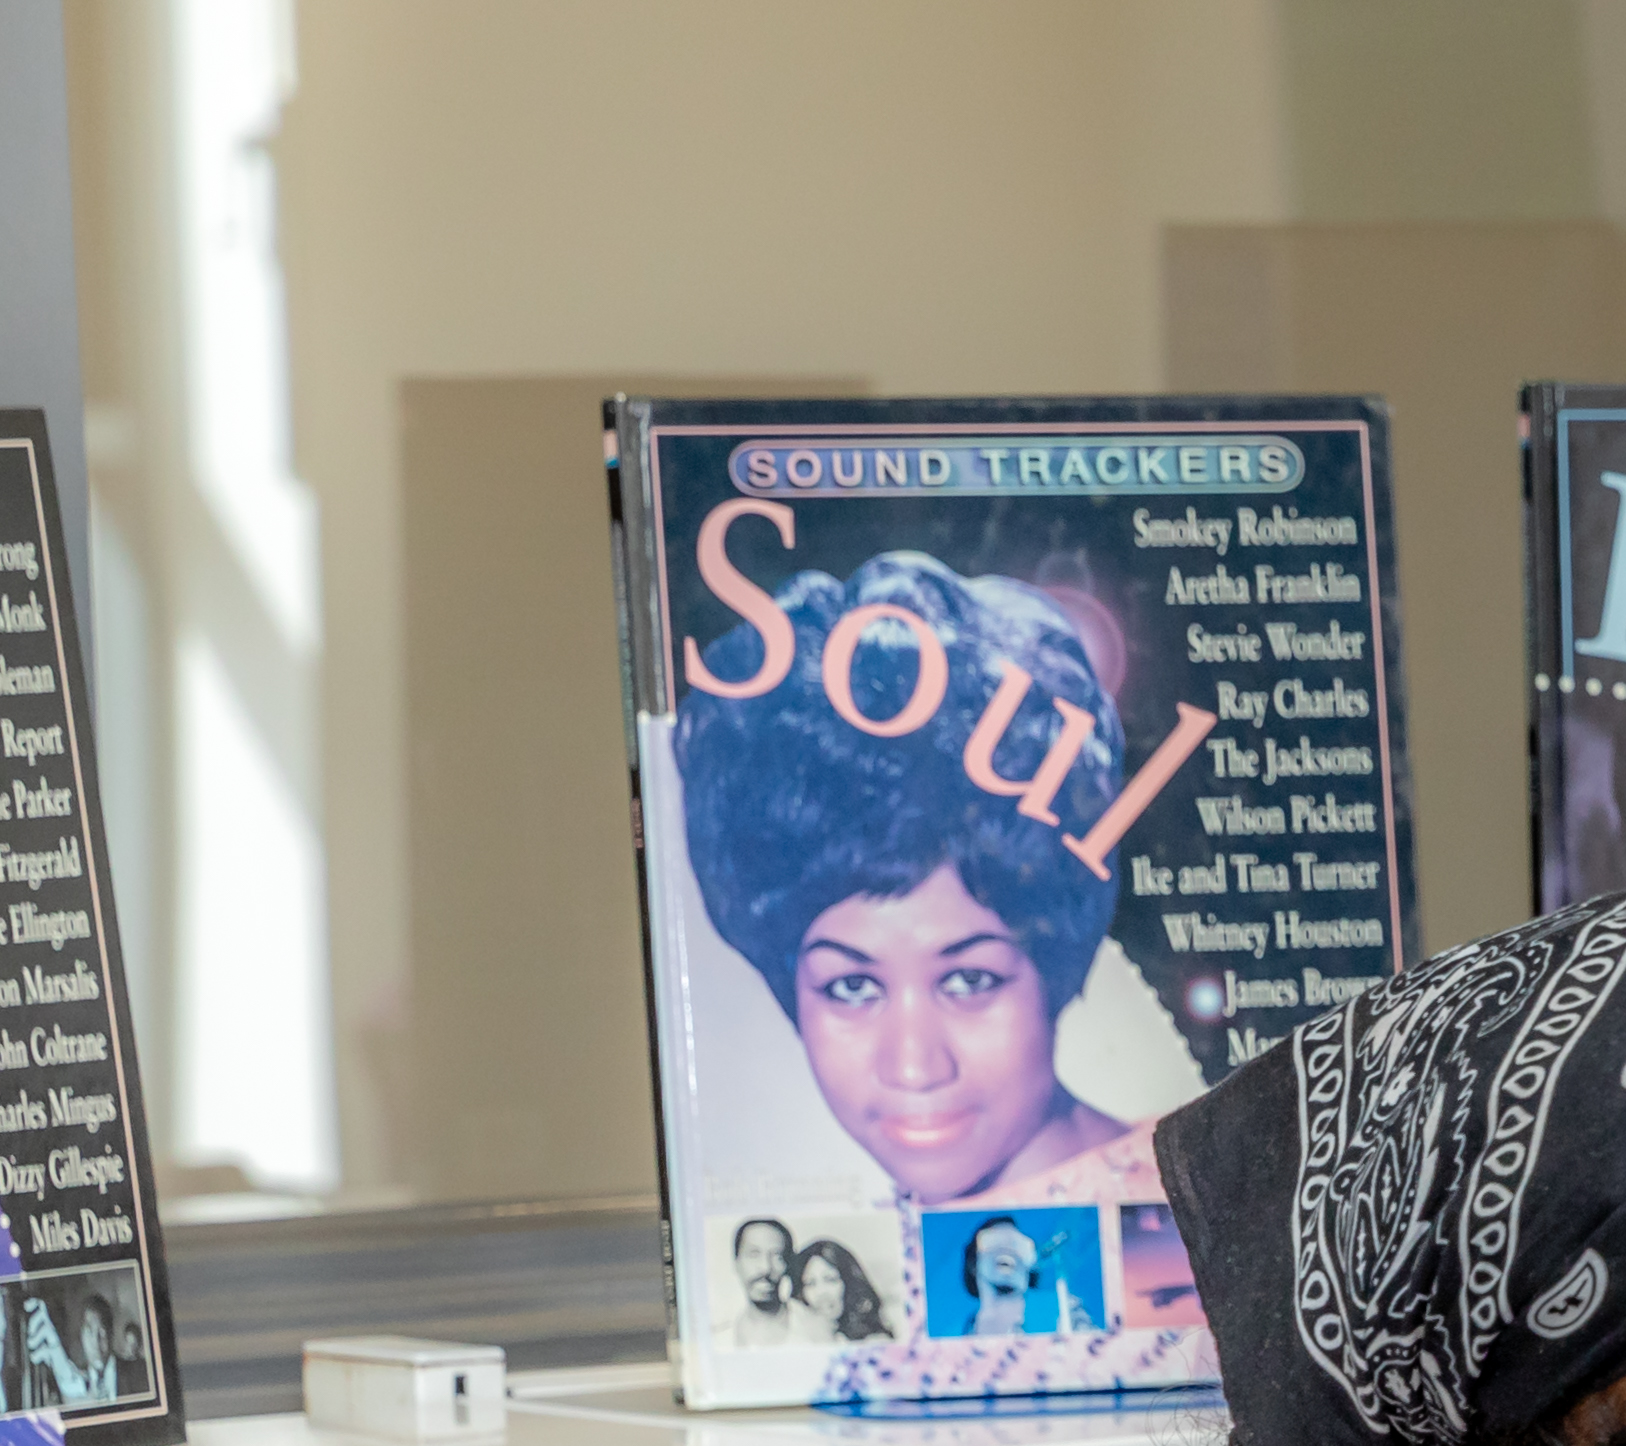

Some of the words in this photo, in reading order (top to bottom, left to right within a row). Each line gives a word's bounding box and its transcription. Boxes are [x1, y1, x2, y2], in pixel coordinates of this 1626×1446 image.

[747, 447, 953, 487] SOUND
[979, 445, 1292, 486] TRACKERS
[1132, 507, 1232, 556] Smokey
[1237, 505, 1358, 546] Robinson
[1165, 563, 1250, 605] Aretha
[1255, 562, 1361, 603] Franklin
[0, 590, 47, 633] onk
[1187, 622, 1262, 663] Stevie
[1265, 619, 1366, 661] Wonder
[0, 655, 56, 695] leman
[684, 497, 1219, 880] Soul
[1217, 680, 1268, 729] Ray
[1273, 677, 1370, 719] Charles
[0, 718, 65, 766] Report
[1206, 737, 1260, 778] The
[1262, 735, 1374, 786] Jacksons
[12, 775, 73, 819] Parker
[1195, 794, 1287, 836] Wilson
[1289, 792, 1377, 833] Pickett
[1131, 855, 1174, 896] Ike
[1178, 853, 1227, 894] and
[1229, 854, 1290, 893] Tina
[1293, 852, 1381, 891] Turner
[9, 902, 91, 950] Ellington
[1162, 911, 1270, 959] Whitney
[1274, 910, 1384, 949] Houston
[23, 959, 100, 1004] Marsalis
[1223, 970, 1300, 1018] James
[0, 1029, 29, 1070] ohn
[30, 1024, 109, 1067] Coltrane
[0, 1089, 48, 1133] arles
[48, 1086, 118, 1134] Mingus
[0, 1154, 45, 1202] Dizzy
[49, 1145, 125, 1194] Gillespie
[30, 1211, 81, 1254] Miles
[81, 1205, 134, 1248] Davis
